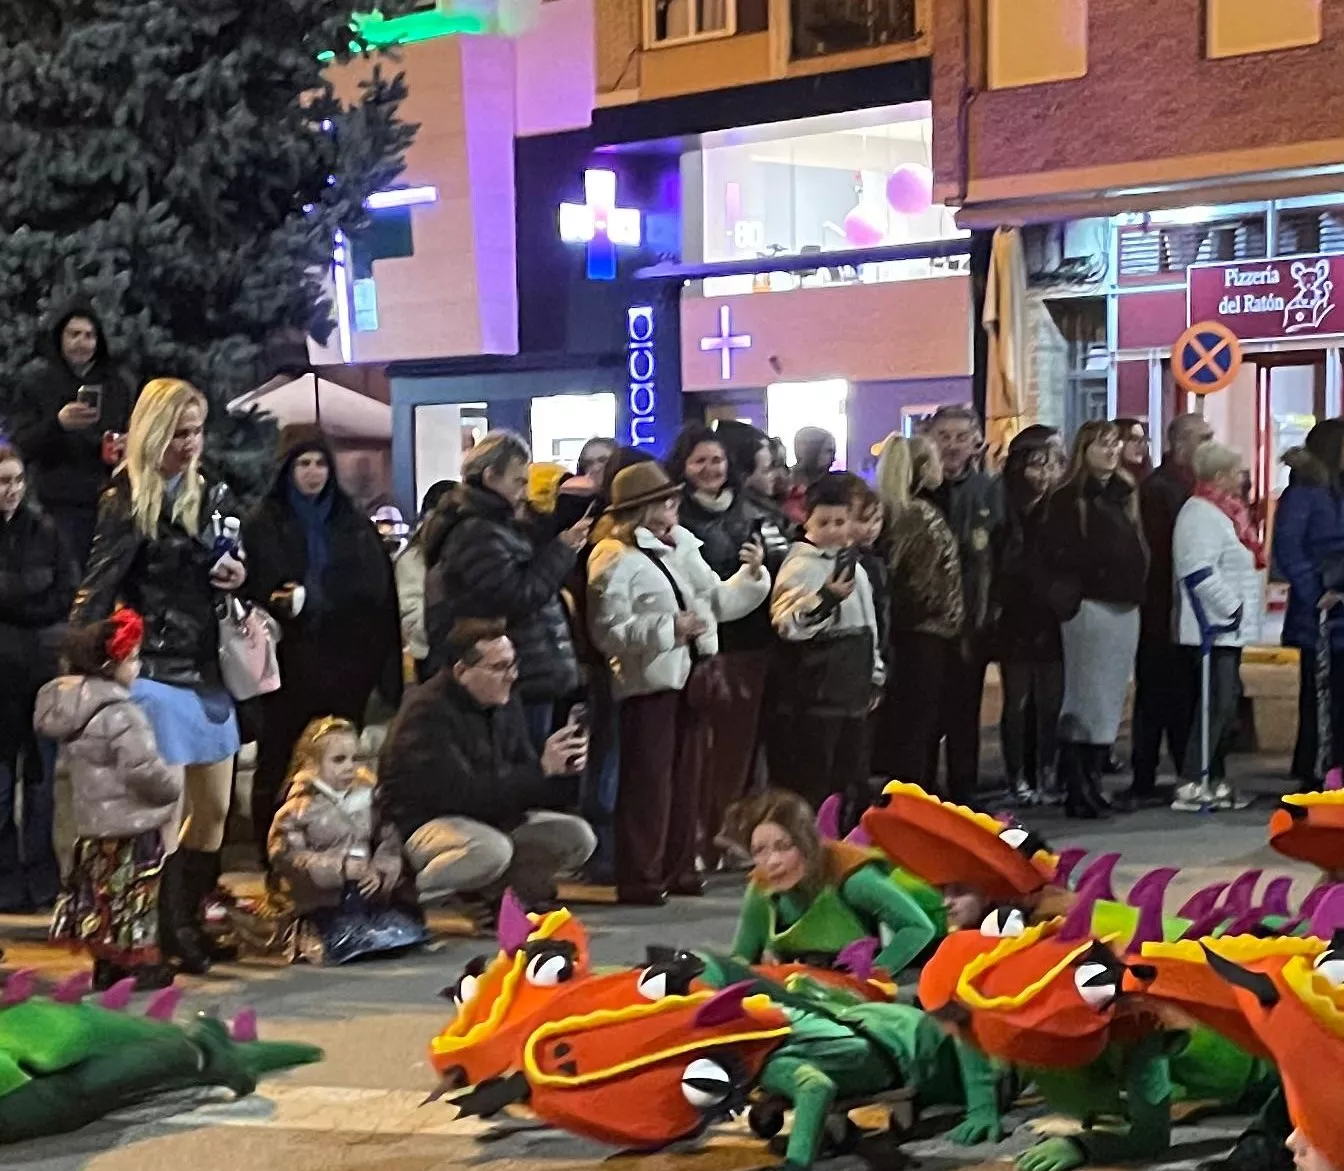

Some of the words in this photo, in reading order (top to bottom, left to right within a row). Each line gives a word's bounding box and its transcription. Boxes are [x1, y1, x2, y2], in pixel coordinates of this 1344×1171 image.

[1224, 265, 1280, 287] Pizzería
[1219, 295, 1241, 314] del
[1244, 293, 1284, 313] Ratón
